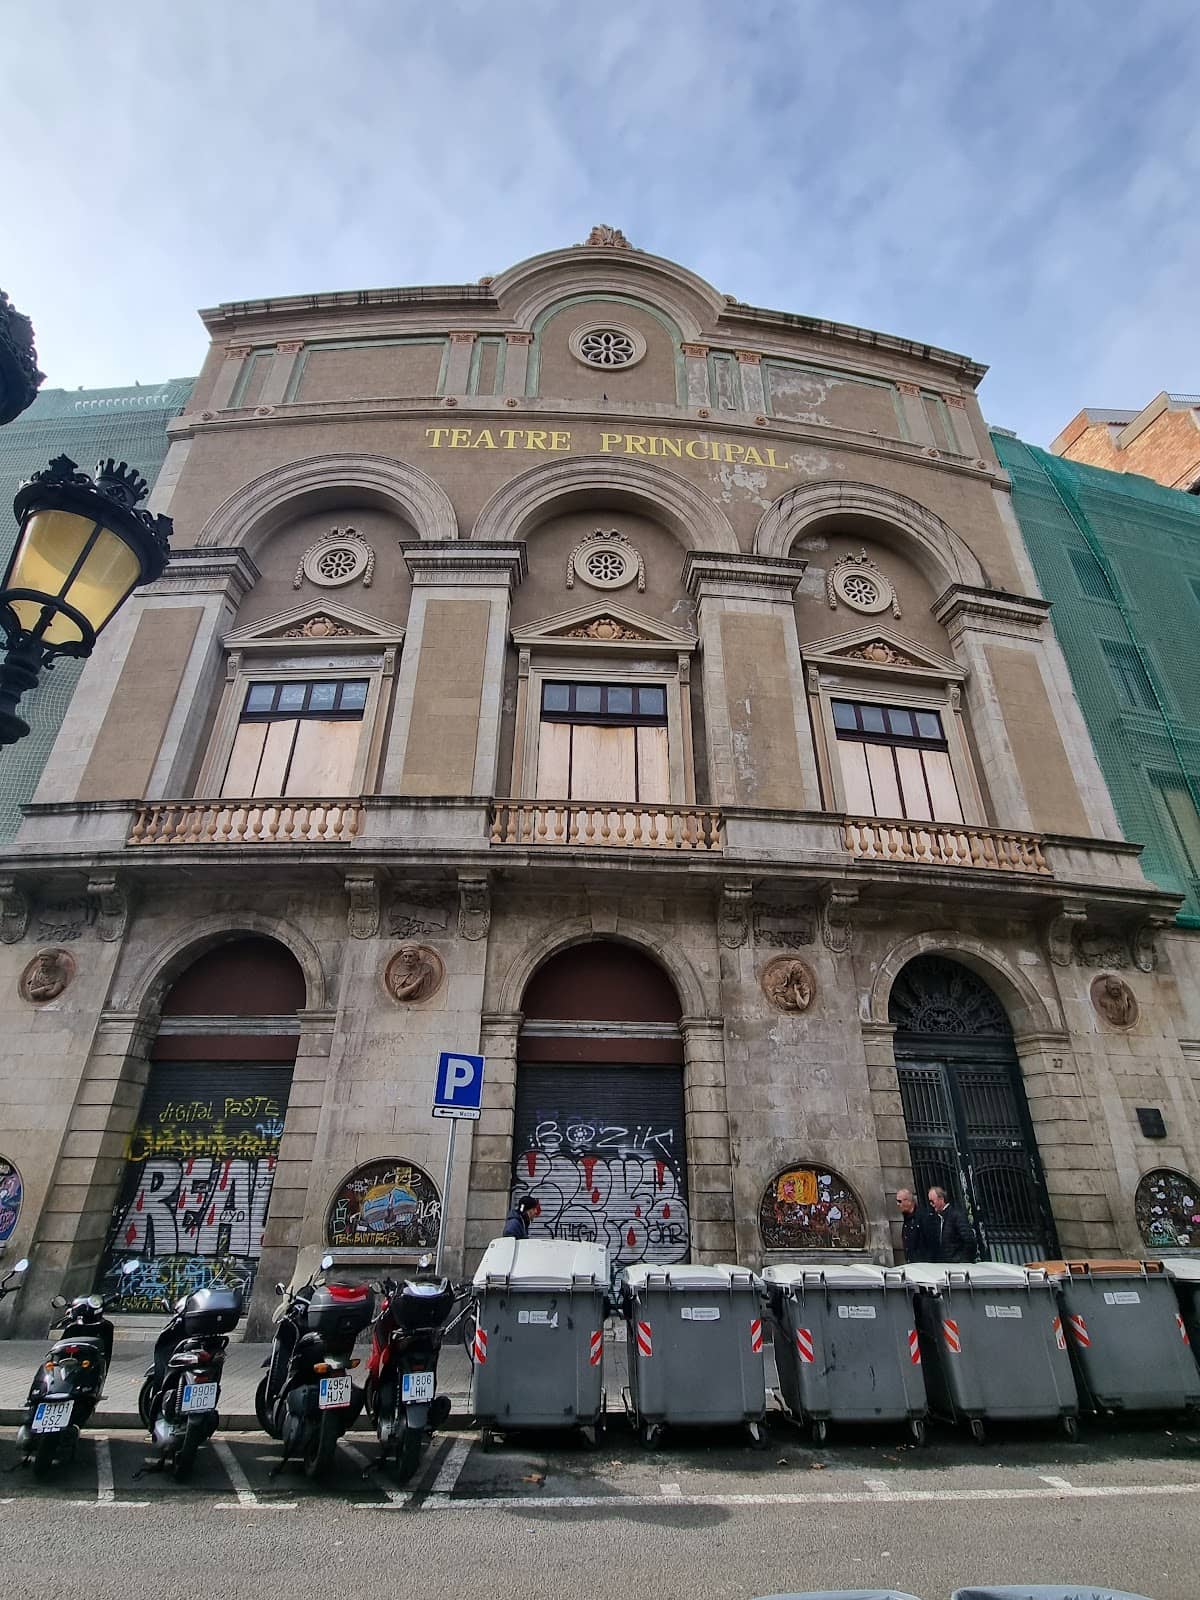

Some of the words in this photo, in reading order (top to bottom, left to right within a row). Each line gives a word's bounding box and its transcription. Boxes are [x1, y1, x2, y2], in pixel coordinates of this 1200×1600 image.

[425, 428, 571, 451] TEATRE
[600, 433, 789, 469] PRINCIPAL
[444, 1058, 475, 1100] P
[327, 1378, 349, 1390] 4954
[411, 1374, 432, 1386] 1806
[327, 1390, 344, 1402] HJX
[410, 1386, 426, 1398] LHH
[41, 1414, 62, 1426] GSZ
